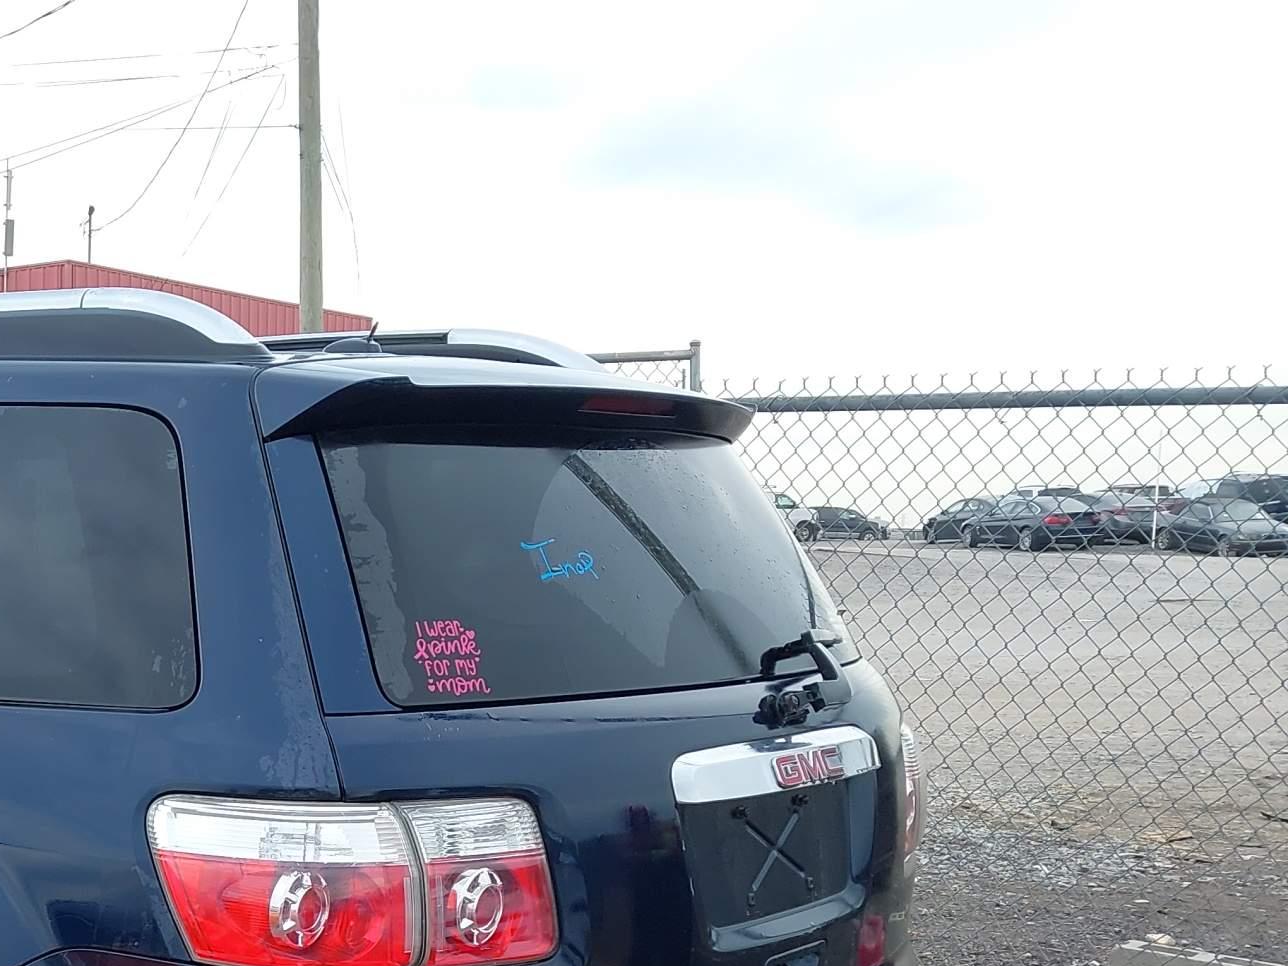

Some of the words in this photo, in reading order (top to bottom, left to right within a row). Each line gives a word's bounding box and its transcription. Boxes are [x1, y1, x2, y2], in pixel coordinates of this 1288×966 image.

[415, 620, 423, 638] I
[423, 620, 462, 637] wear
[435, 677, 491, 696] mom
[773, 745, 845, 788] GMC
